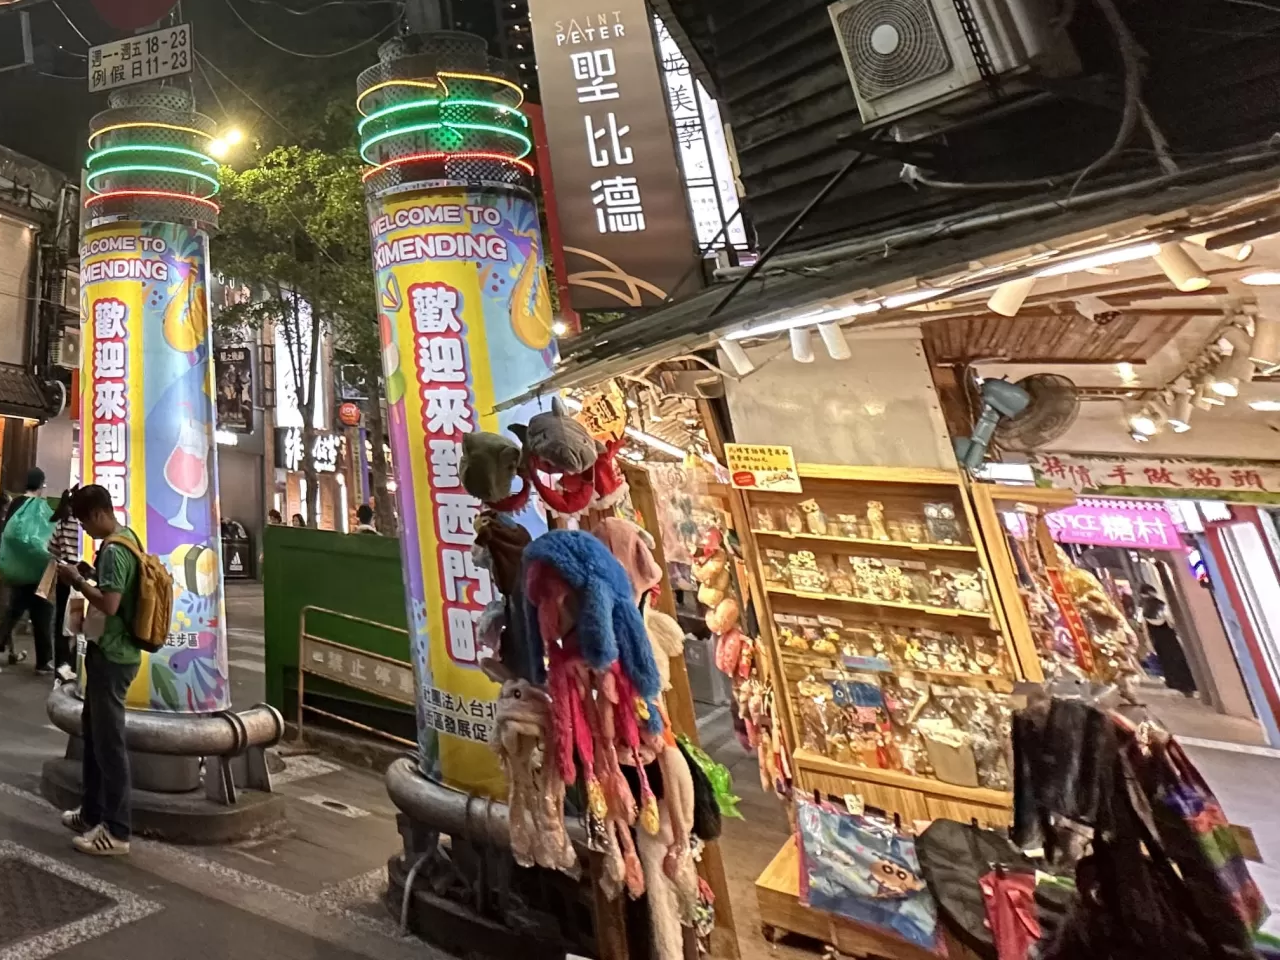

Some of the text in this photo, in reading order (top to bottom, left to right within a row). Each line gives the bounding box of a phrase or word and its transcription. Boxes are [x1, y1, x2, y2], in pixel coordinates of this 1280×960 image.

[554, 10, 623, 38] SAINT
[556, 23, 626, 47] PETER
[570, 47, 647, 234] 聖比德
[370, 205, 502, 239] WELCOME TO
[139, 237, 167, 253] TO
[373, 234, 508, 271] XIMENDING
[94, 300, 127, 526] 歡迎來到西
[425, 709, 494, 743] 街區發展促
